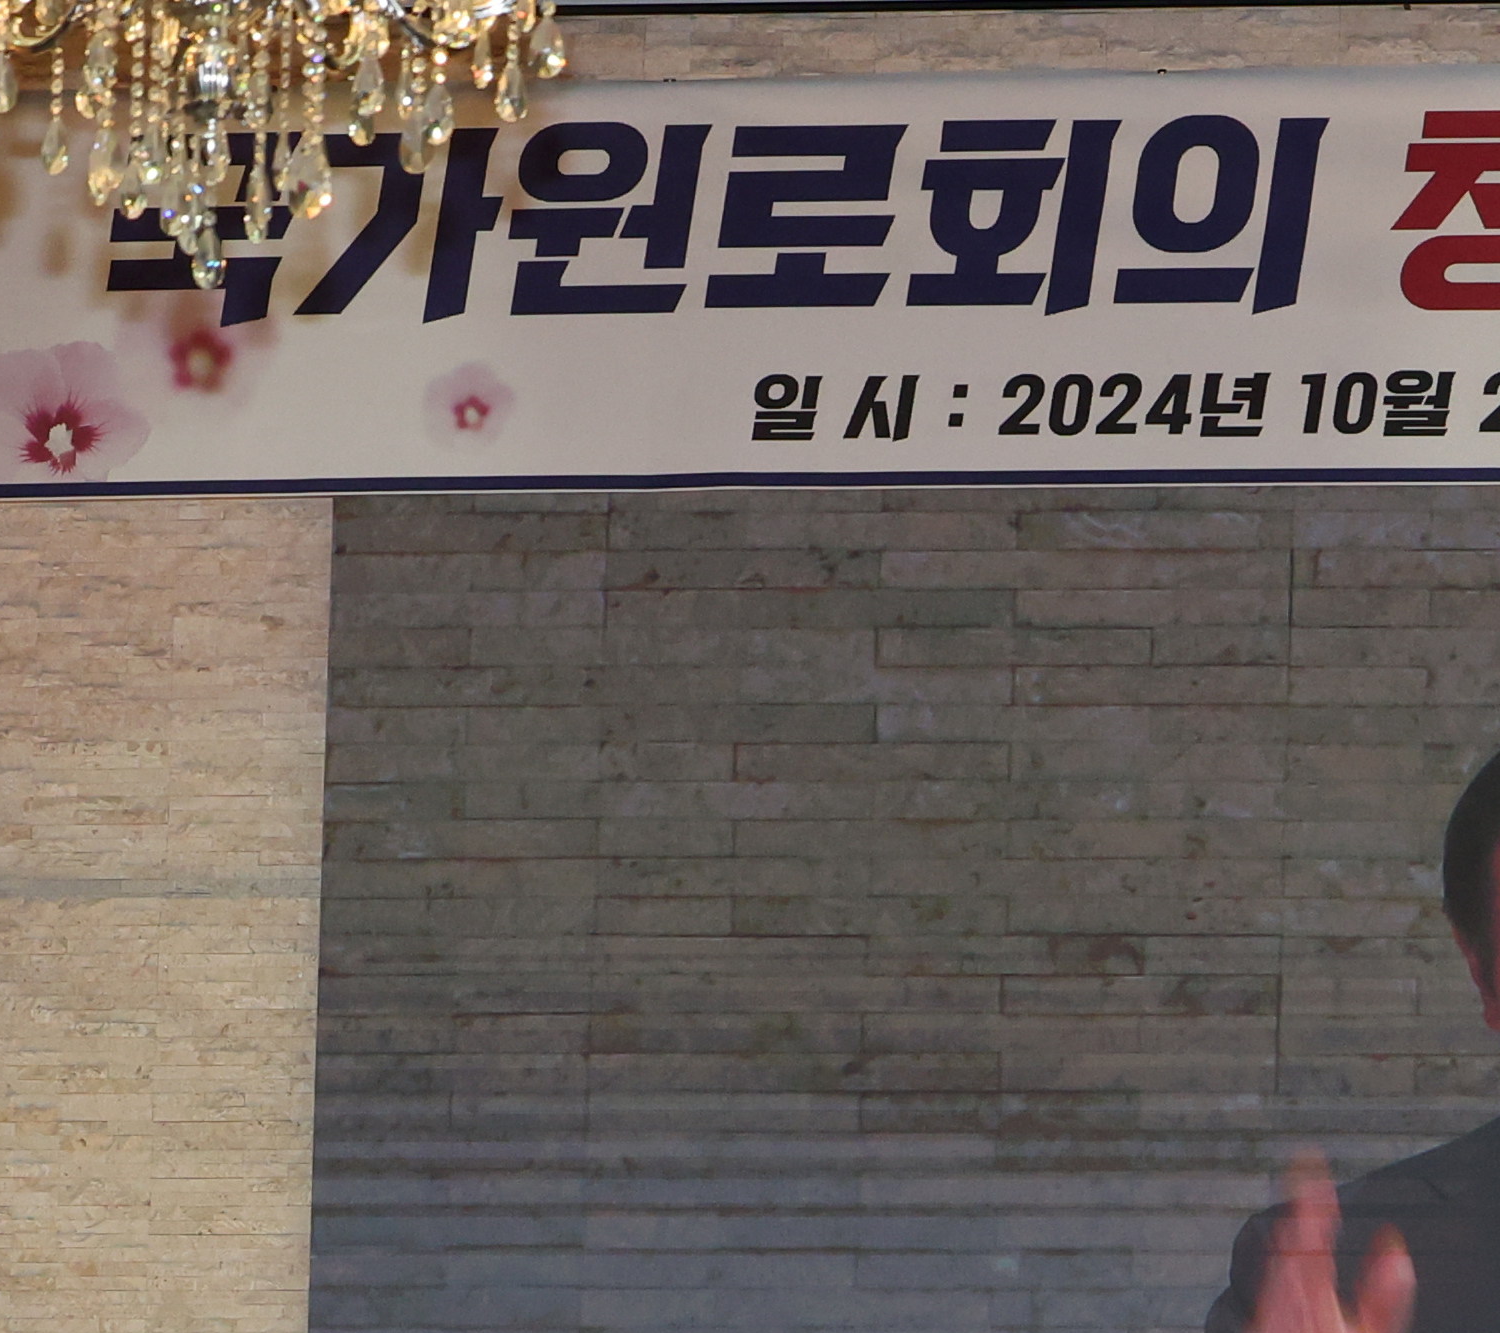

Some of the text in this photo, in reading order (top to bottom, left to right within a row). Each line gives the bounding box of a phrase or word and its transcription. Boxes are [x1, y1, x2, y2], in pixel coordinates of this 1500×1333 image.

[107, 114, 1329, 328] 국가원로회의
[998, 372, 1271, 438] 2024년
[1300, 369, 1456, 437] 10월
